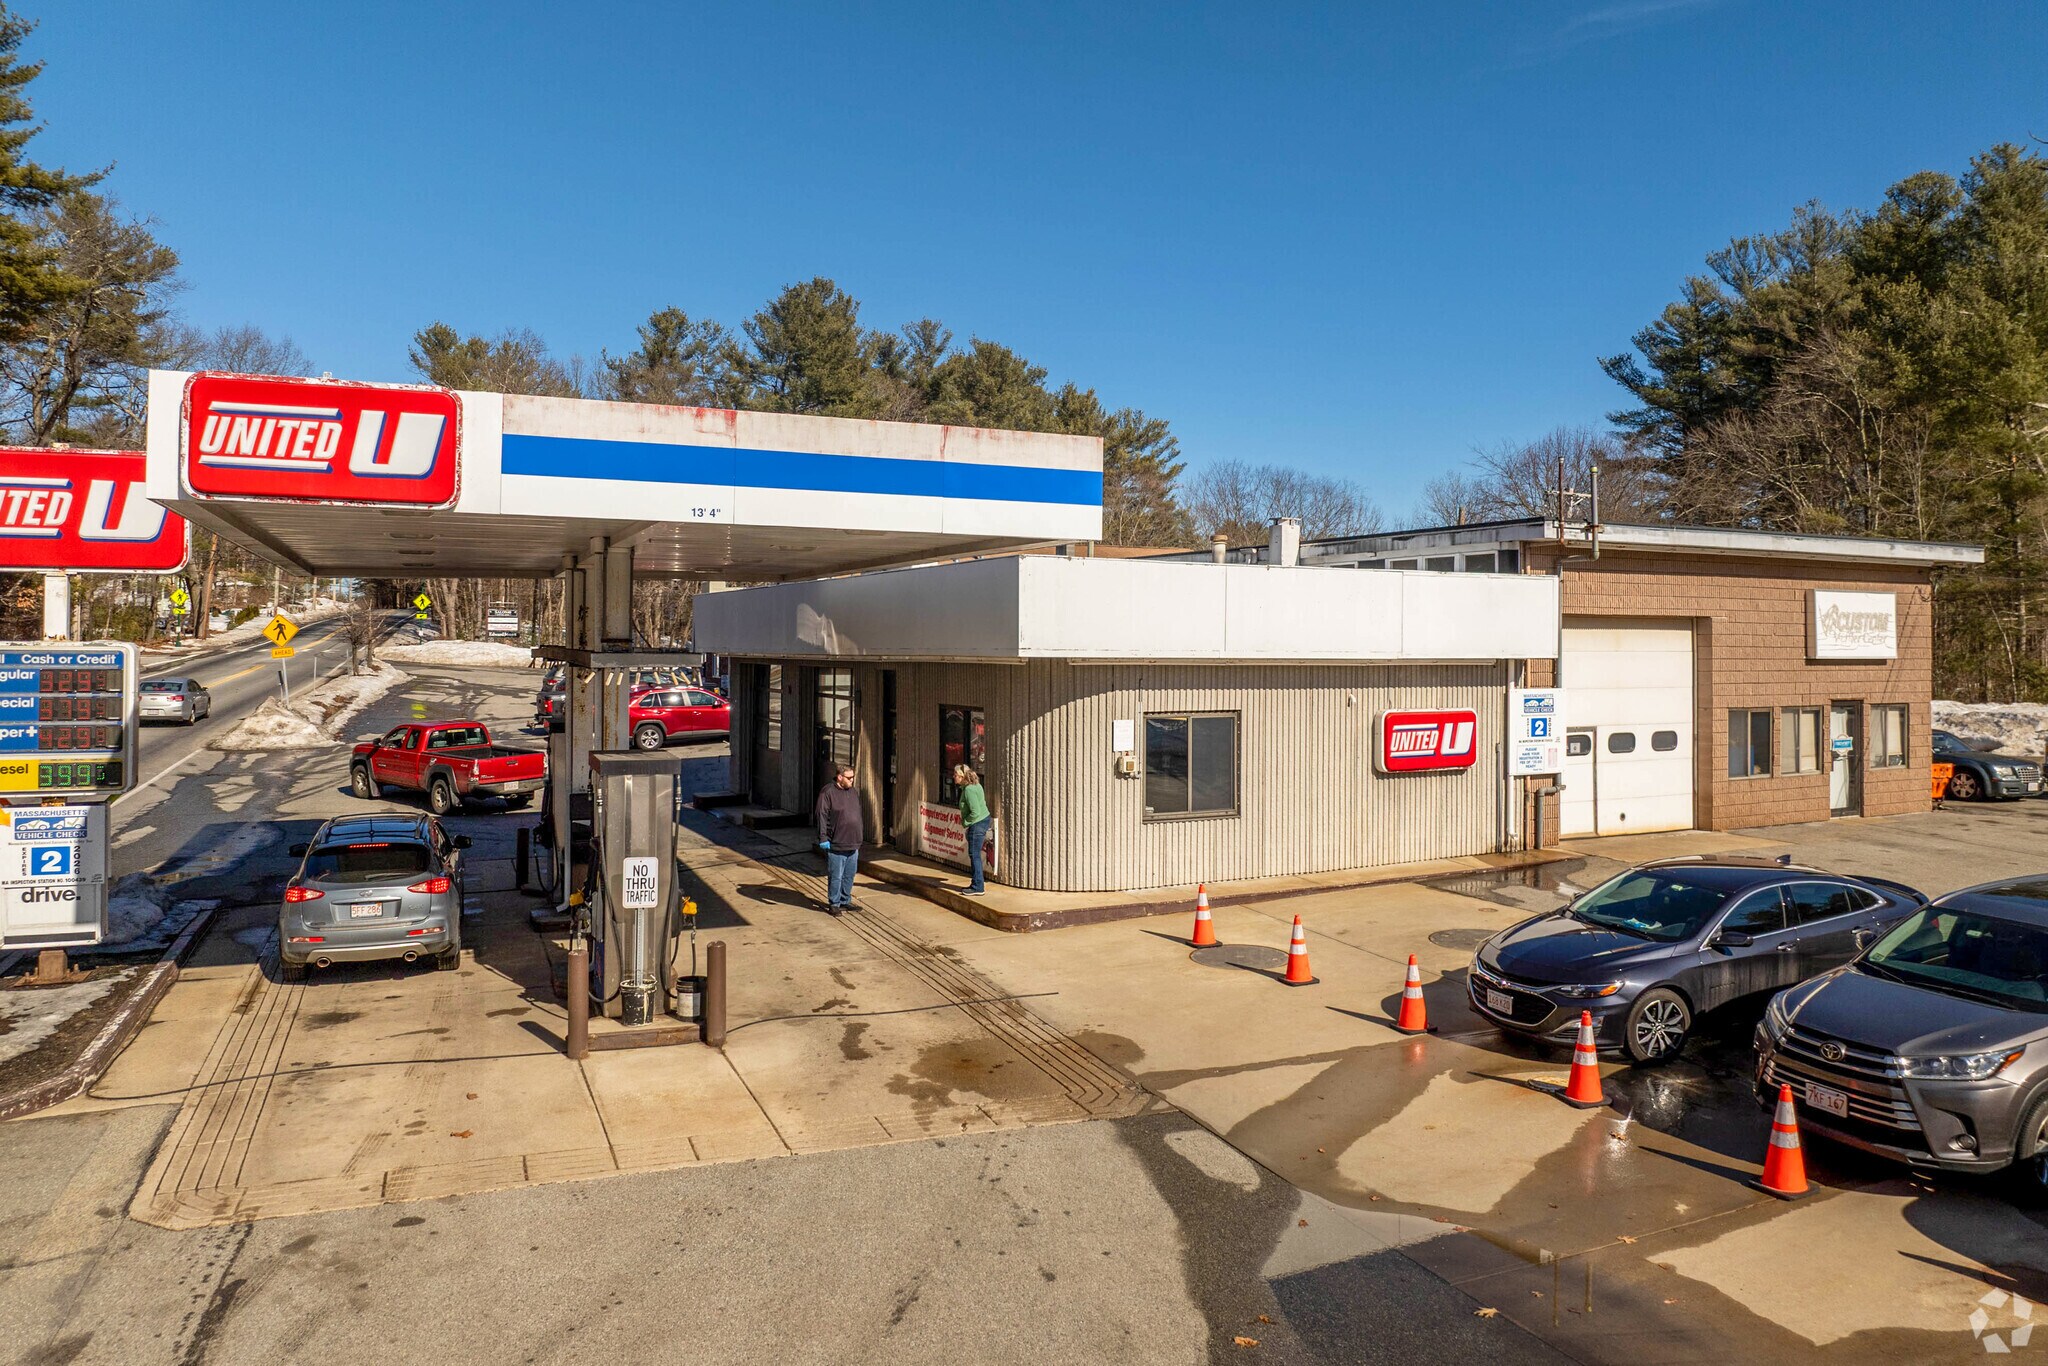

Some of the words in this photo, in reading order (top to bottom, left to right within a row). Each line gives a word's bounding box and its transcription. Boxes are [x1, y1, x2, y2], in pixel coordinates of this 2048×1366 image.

[200, 415, 343, 459] UNITED
[349, 409, 447, 478] U
[79, 479, 168, 542] U
[691, 508, 706, 517] 13'
[710, 508, 721, 517] 4"
[21, 654, 55, 664] Cash
[58, 656, 73, 664] or
[77, 653, 116, 664] Credit
[0, 669, 35, 682] gular
[0, 697, 34, 708] ecial
[0, 726, 38, 741] per+
[1534, 720, 1545, 736] 2
[1390, 730, 1440, 752] UNITED
[1440, 722, 1474, 756] U
[0, 764, 29, 774] esel
[14, 809, 88, 817] MASSACHUSETTS
[920, 805, 949, 822] Computerized
[55, 830, 86, 838] CHECK
[924, 822, 946, 837] Alignment
[946, 827, 964, 842] Service
[41, 851, 62, 872] 2
[632, 864, 648, 877] NO
[626, 877, 655, 889] THRU
[21, 887, 81, 903] drive.
[626, 890, 655, 902] TRAFFIC
[352, 906, 365, 915] 5FF
[367, 905, 380, 914] 286
[1808, 1089, 1825, 1104] 7KF
[1827, 1096, 1845, 1109] 167
